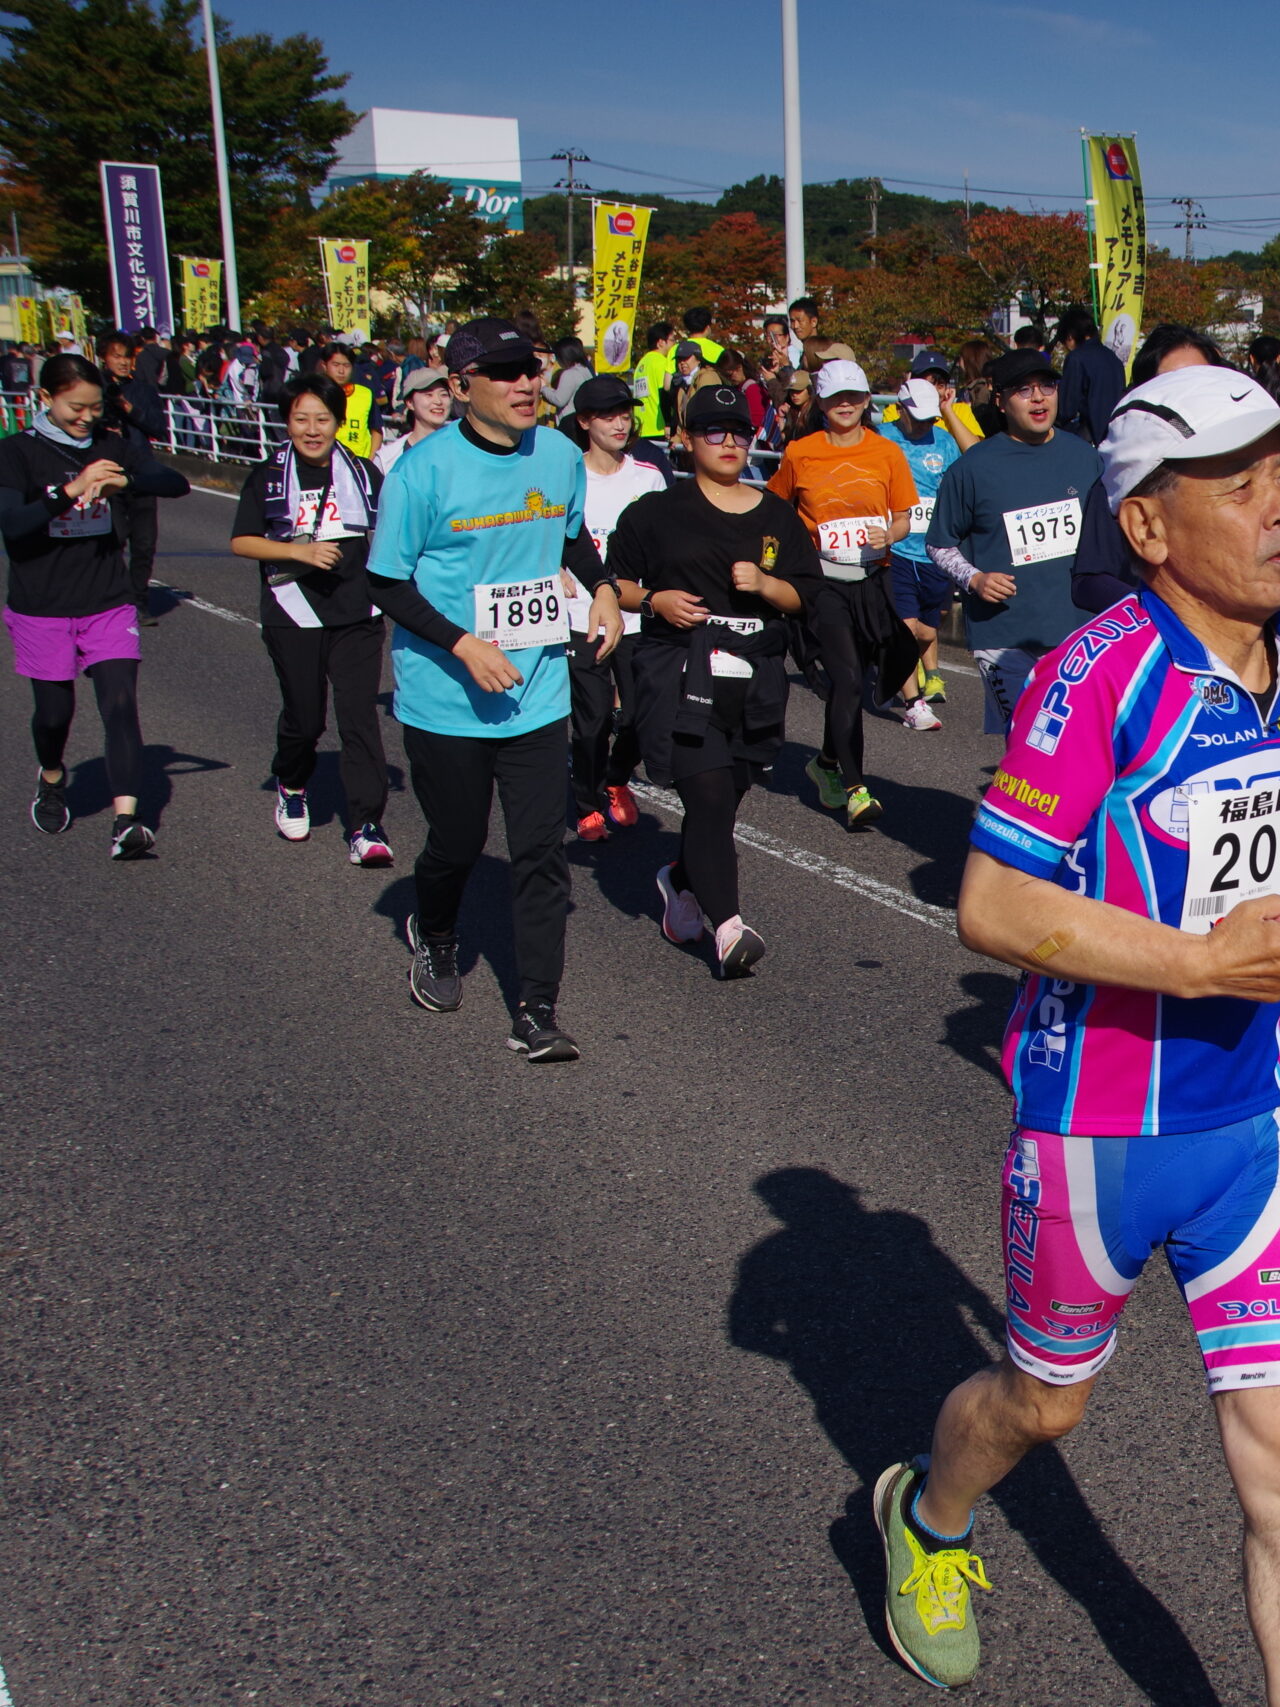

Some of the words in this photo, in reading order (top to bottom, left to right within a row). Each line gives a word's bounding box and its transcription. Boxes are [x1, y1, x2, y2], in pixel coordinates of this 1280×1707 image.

[1111, 204, 1133, 311] メモリアル
[605, 251, 626, 320] メモリアル
[622, 240, 642, 308] 円谷幸吉
[450, 509, 534, 533] SUKAGAWA
[540, 504, 566, 519] GAS
[1024, 503, 1071, 520] エイジェック
[1017, 514, 1076, 546] 1975
[490, 580, 554, 599] 福島トヨタ
[488, 594, 559, 629] 1899
[1190, 728, 1258, 748] DOLAN
[1058, 1304, 1096, 1314] Santini
[1240, 1372, 1266, 1381] Santini
